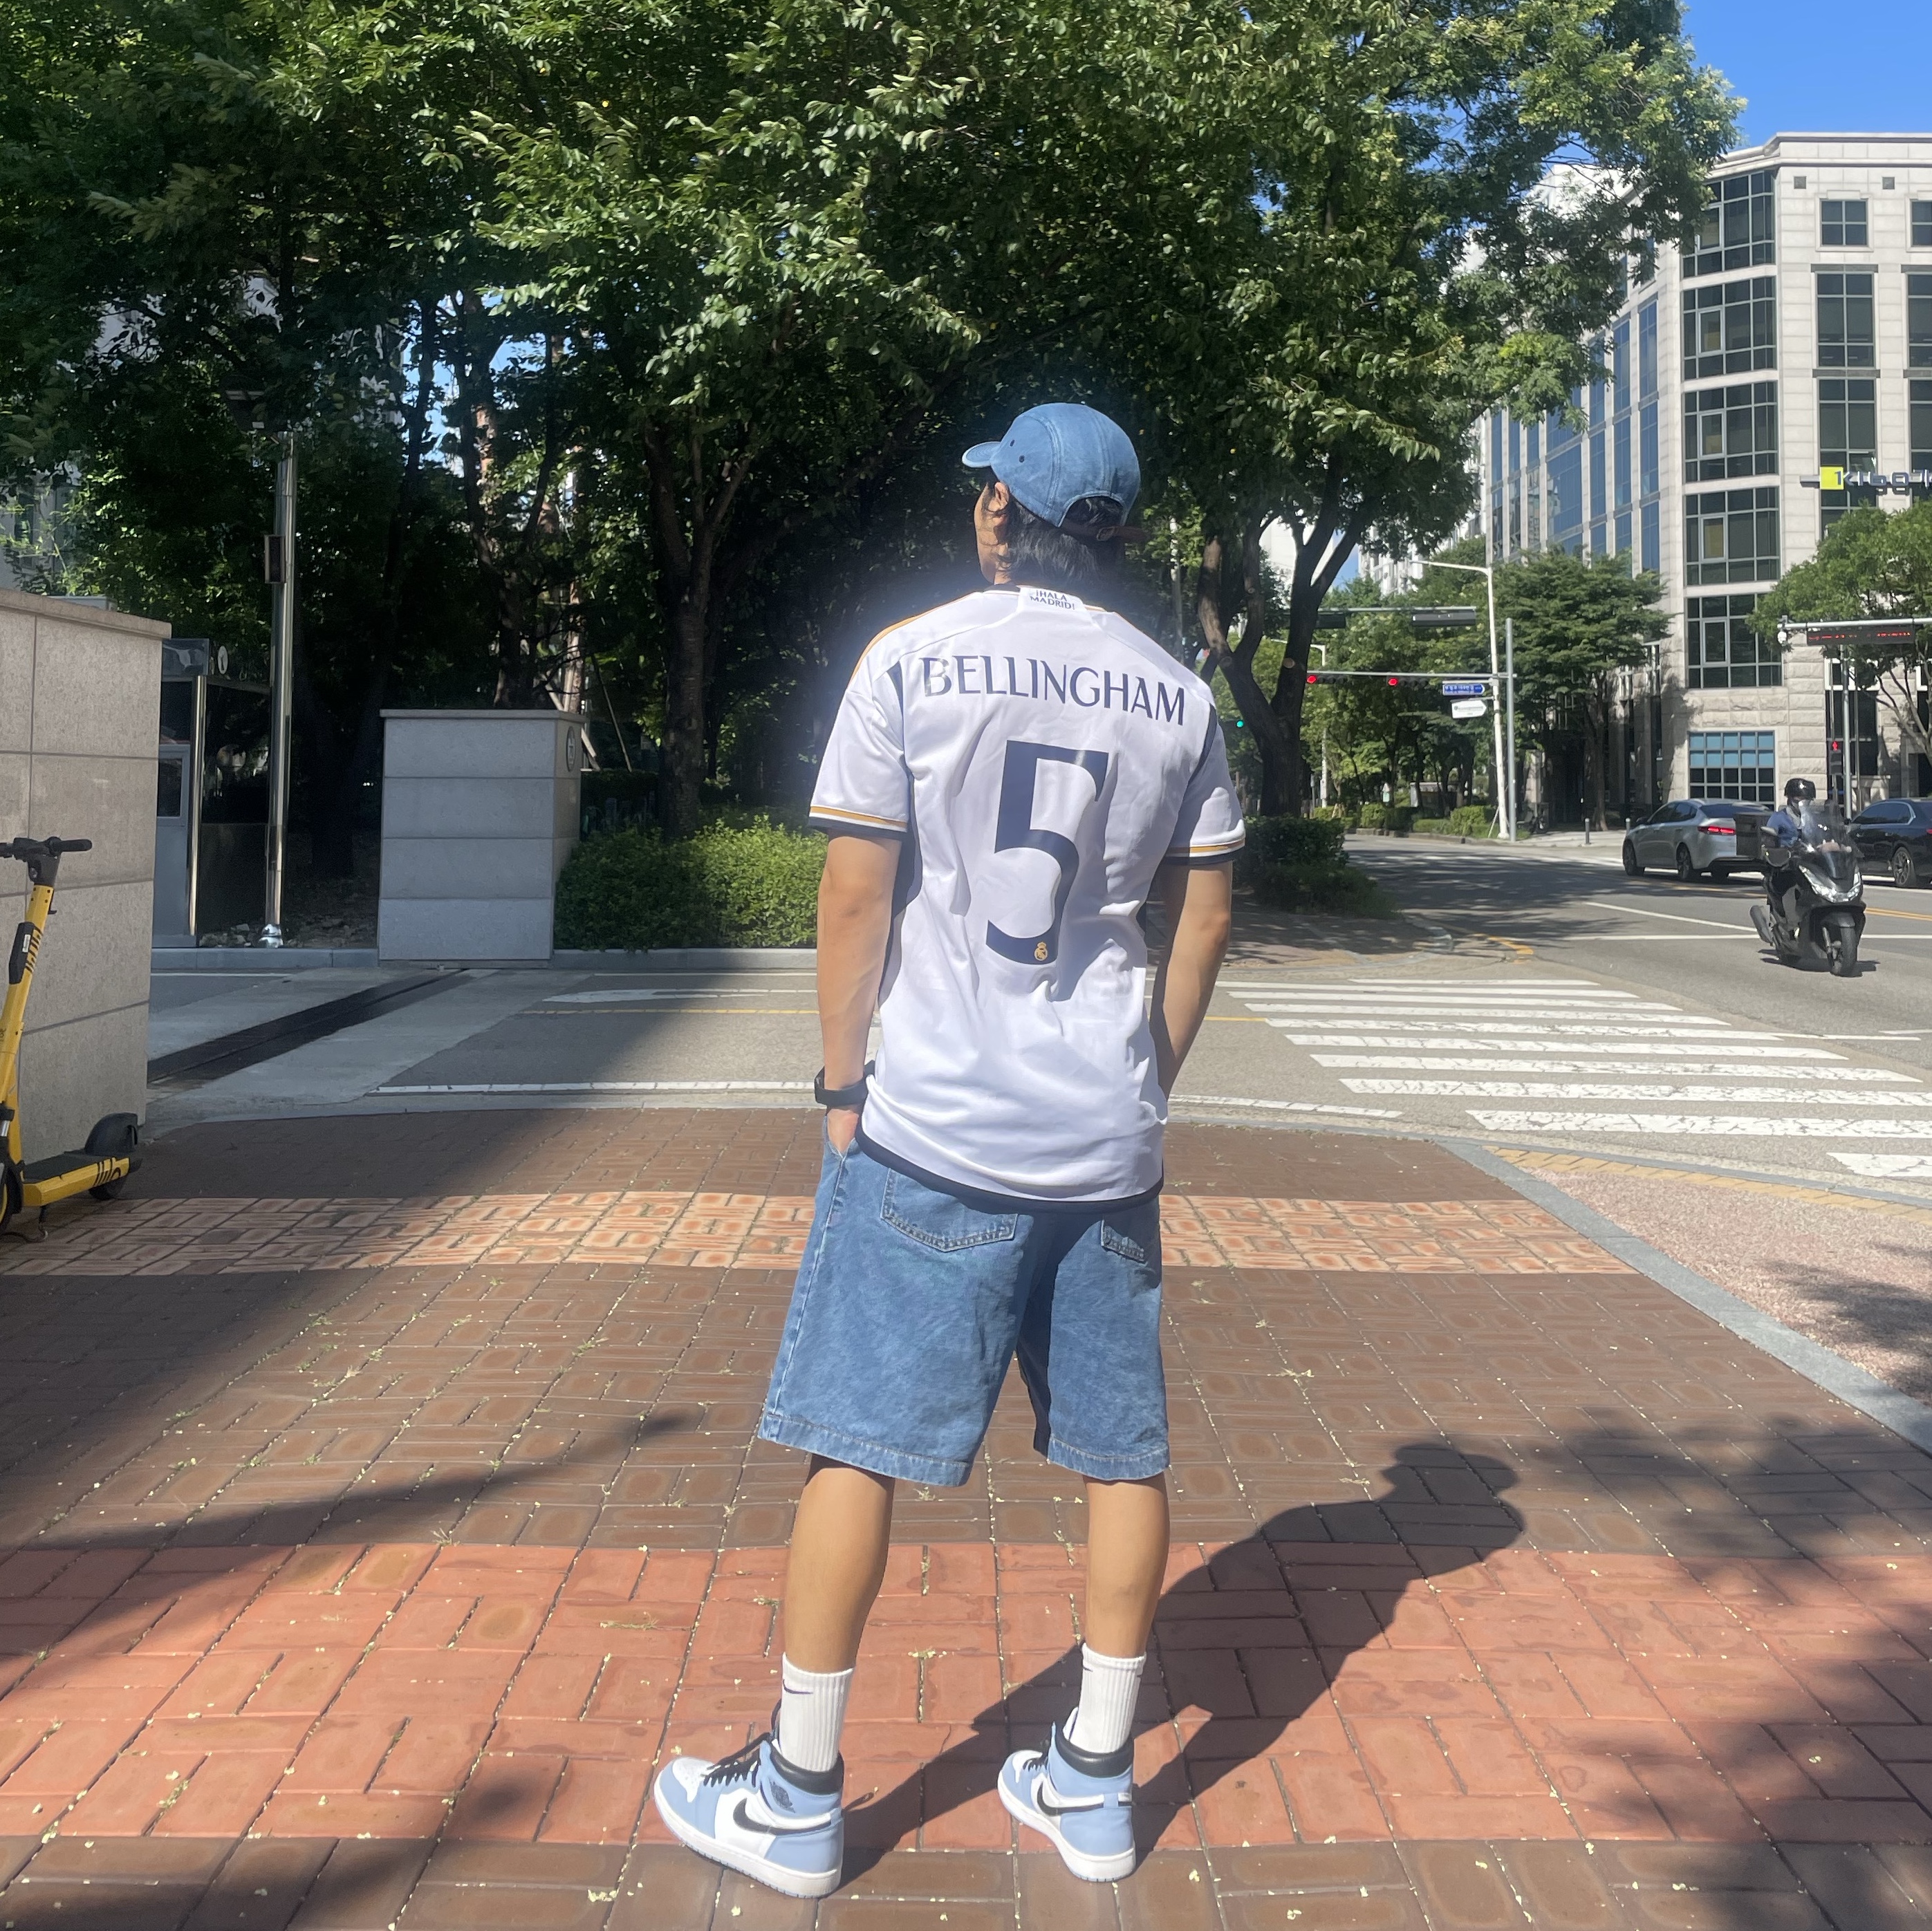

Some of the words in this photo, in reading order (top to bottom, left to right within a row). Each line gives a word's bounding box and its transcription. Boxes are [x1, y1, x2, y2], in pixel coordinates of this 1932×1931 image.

[1030, 595, 1075, 610] MADRID!
[918, 655, 1185, 726] BELLINGHAM
[985, 740, 1109, 965] 5
